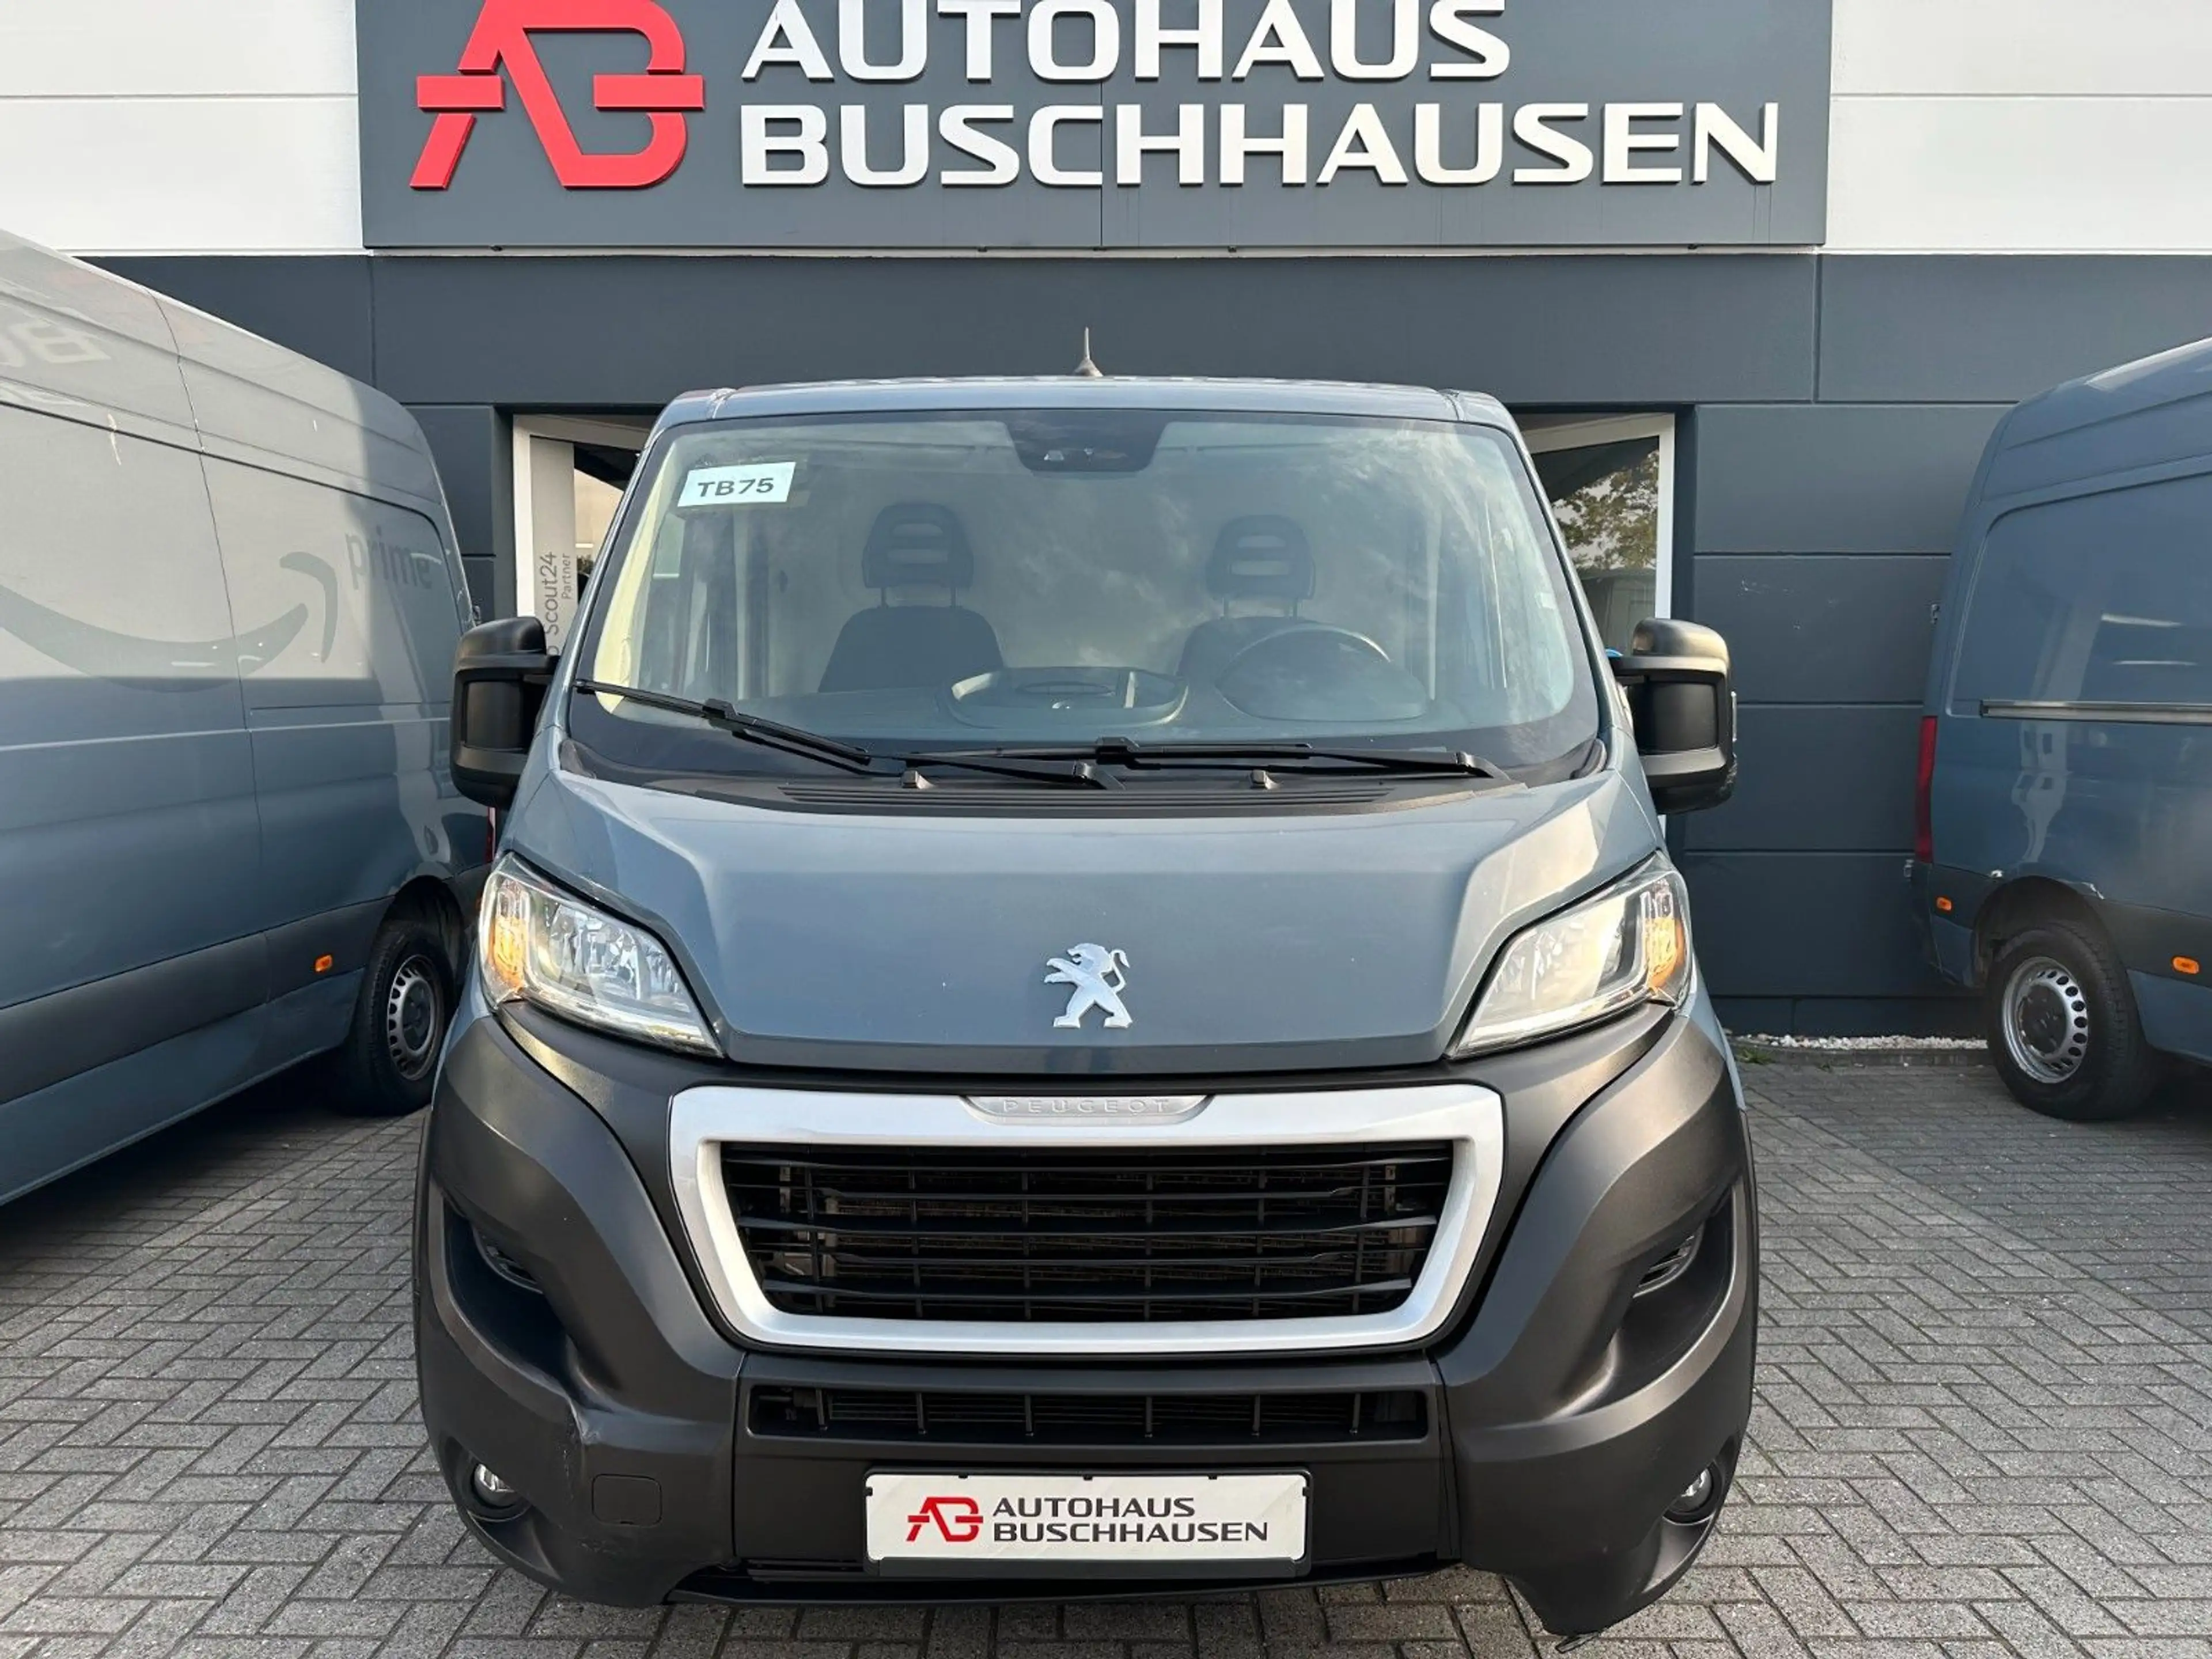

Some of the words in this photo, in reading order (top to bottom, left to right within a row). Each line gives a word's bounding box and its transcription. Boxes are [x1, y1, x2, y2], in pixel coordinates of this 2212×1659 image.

[741, 0, 1511, 81] AUTOHAUS
[741, 101, 1779, 185] BUSCHHAUSEN
[697, 477, 775, 498] TB75
[345, 524, 433, 590] prime
[561, 552, 571, 600] Partner
[1003, 1099, 1169, 1113] PEUGEOT
[992, 1497, 1195, 1518] AUTOHAUS
[993, 1521, 1268, 1543] BUSCHHAUSEN
